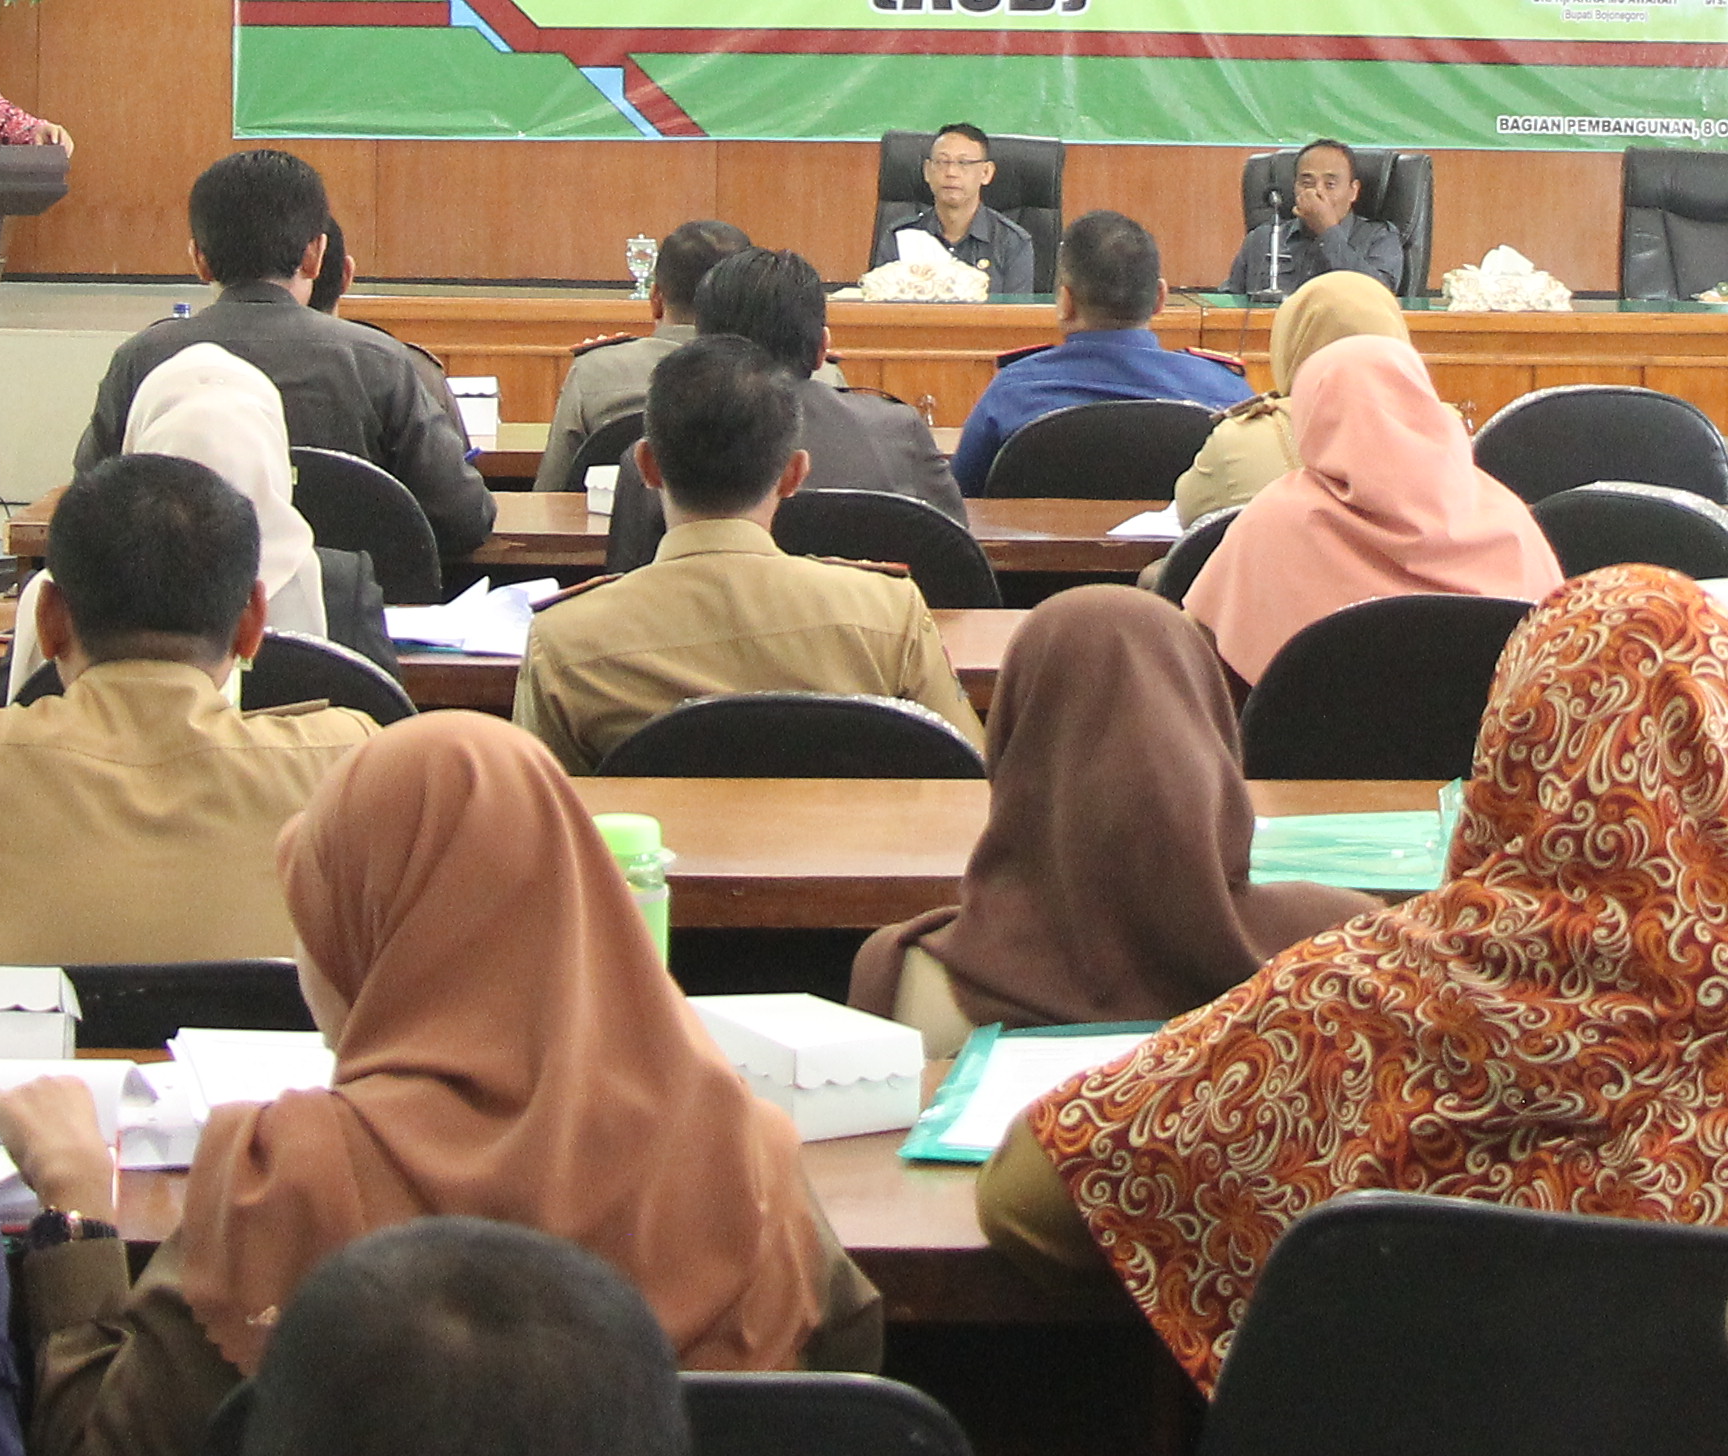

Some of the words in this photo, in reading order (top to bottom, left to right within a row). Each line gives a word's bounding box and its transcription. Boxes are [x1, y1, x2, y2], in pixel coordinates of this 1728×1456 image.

[1499, 117, 1561, 132] BAGIAN
[1567, 119, 1699, 138] PEMBANGUNAN,
[1702, 121, 1712, 135] 8
